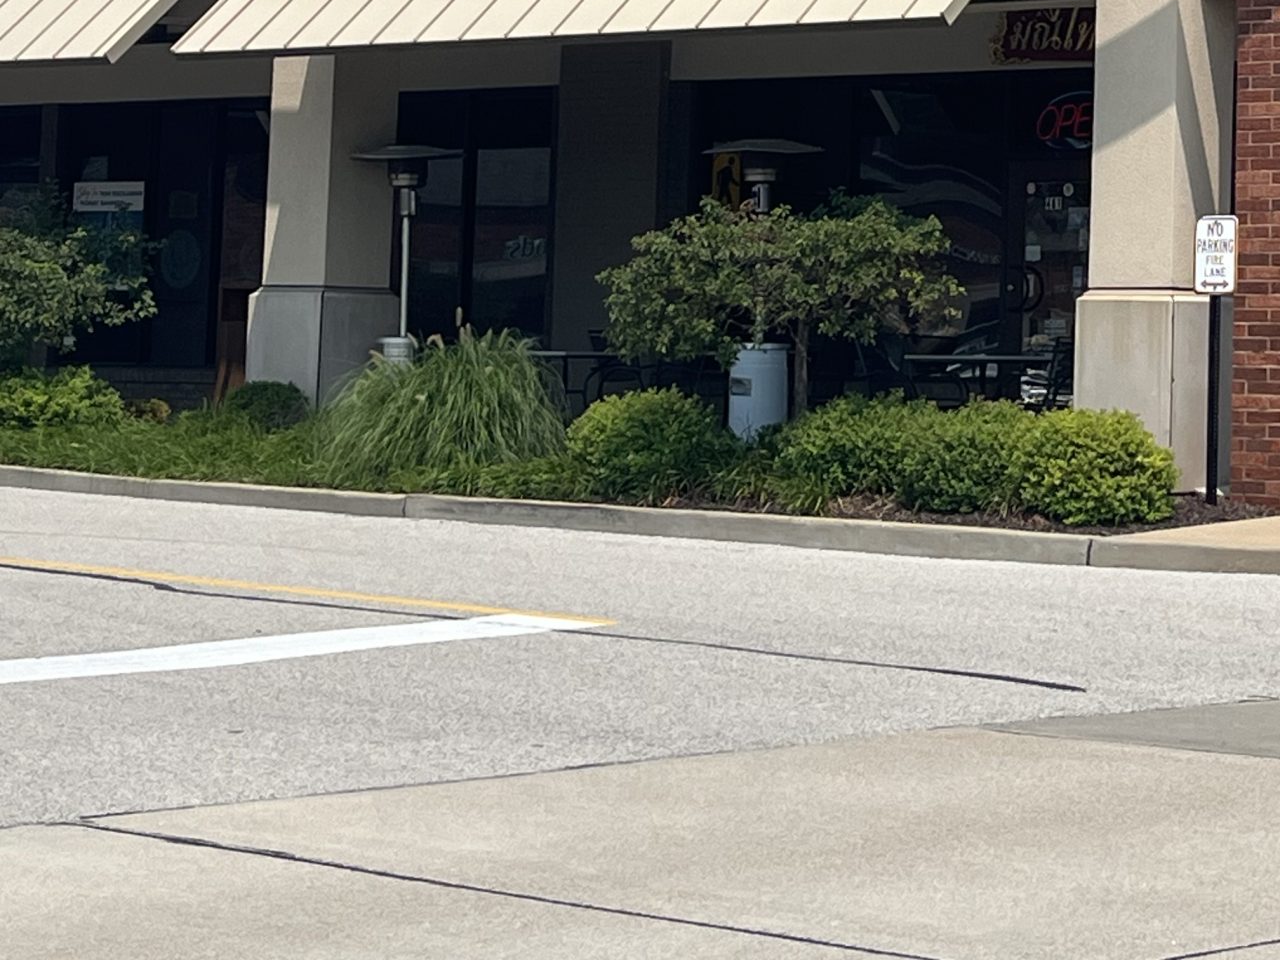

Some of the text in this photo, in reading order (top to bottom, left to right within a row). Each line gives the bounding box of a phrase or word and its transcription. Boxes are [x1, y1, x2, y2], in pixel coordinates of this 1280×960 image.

[1036, 103, 1092, 140] OPE
[1207, 222, 1224, 237] NO
[1197, 239, 1234, 253] PARKING
[1205, 255, 1224, 265] FIRE
[1204, 267, 1226, 277] LANE
